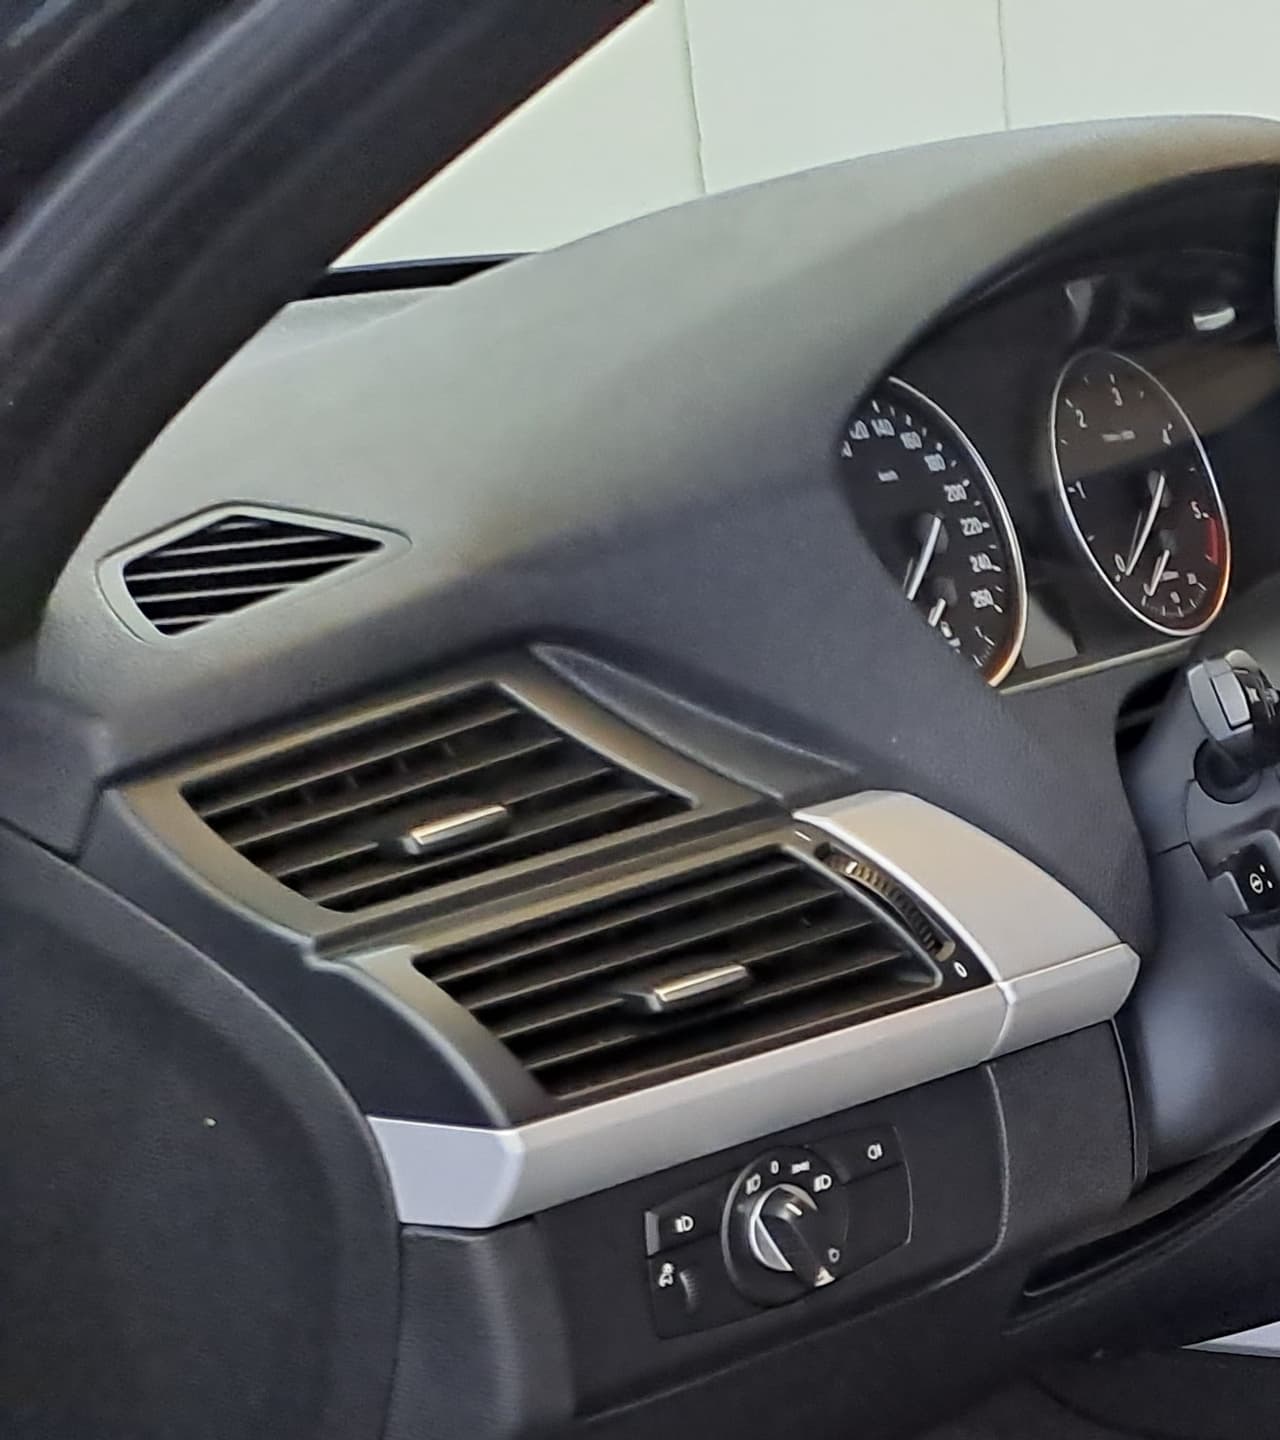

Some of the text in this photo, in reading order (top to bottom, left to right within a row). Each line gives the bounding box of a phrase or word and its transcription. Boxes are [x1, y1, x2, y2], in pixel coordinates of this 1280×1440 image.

[1111, 387, 1123, 406] 3
[1075, 409, 1088, 428] 2
[944, 484, 967, 502] 200
[1190, 501, 1202, 519] 5
[960, 518, 982, 536] 220
[969, 554, 992, 573] 240
[1114, 553, 1125, 573] 0
[970, 590, 994, 608] 260
